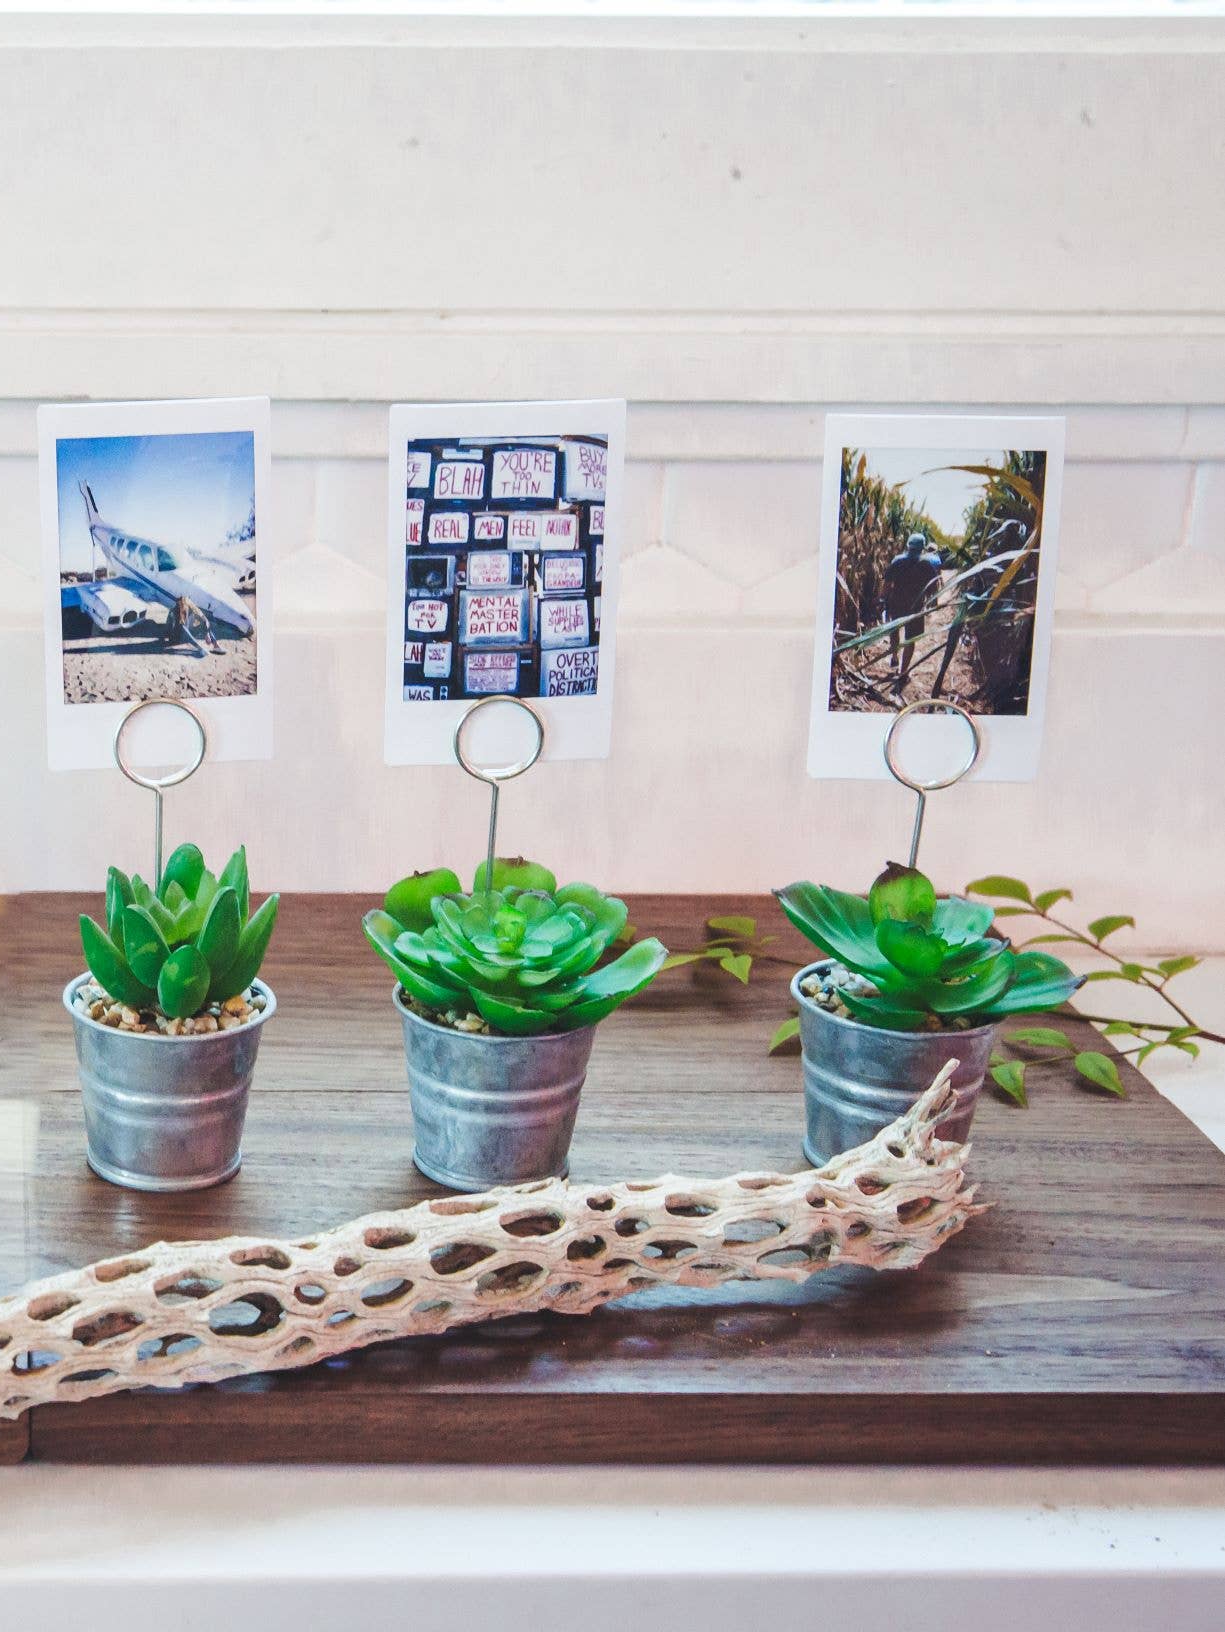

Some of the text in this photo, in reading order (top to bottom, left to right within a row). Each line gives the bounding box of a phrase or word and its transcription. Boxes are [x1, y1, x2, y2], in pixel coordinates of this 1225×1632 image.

[579, 445, 604, 463] BUY
[501, 452, 552, 473] YOU'RE
[439, 466, 483, 495] BLAH
[513, 471, 532, 480] TOO
[501, 480, 540, 495] THIN
[434, 519, 464, 539] REAL
[478, 521, 502, 537] MEN
[512, 520, 536, 537] FEEL
[469, 596, 518, 609] MENTAL
[470, 609, 519, 621] MASTER
[549, 605, 582, 617] WHILE
[415, 618, 438, 629] TV
[469, 621, 518, 635] BATION
[556, 651, 599, 669] OVERT
